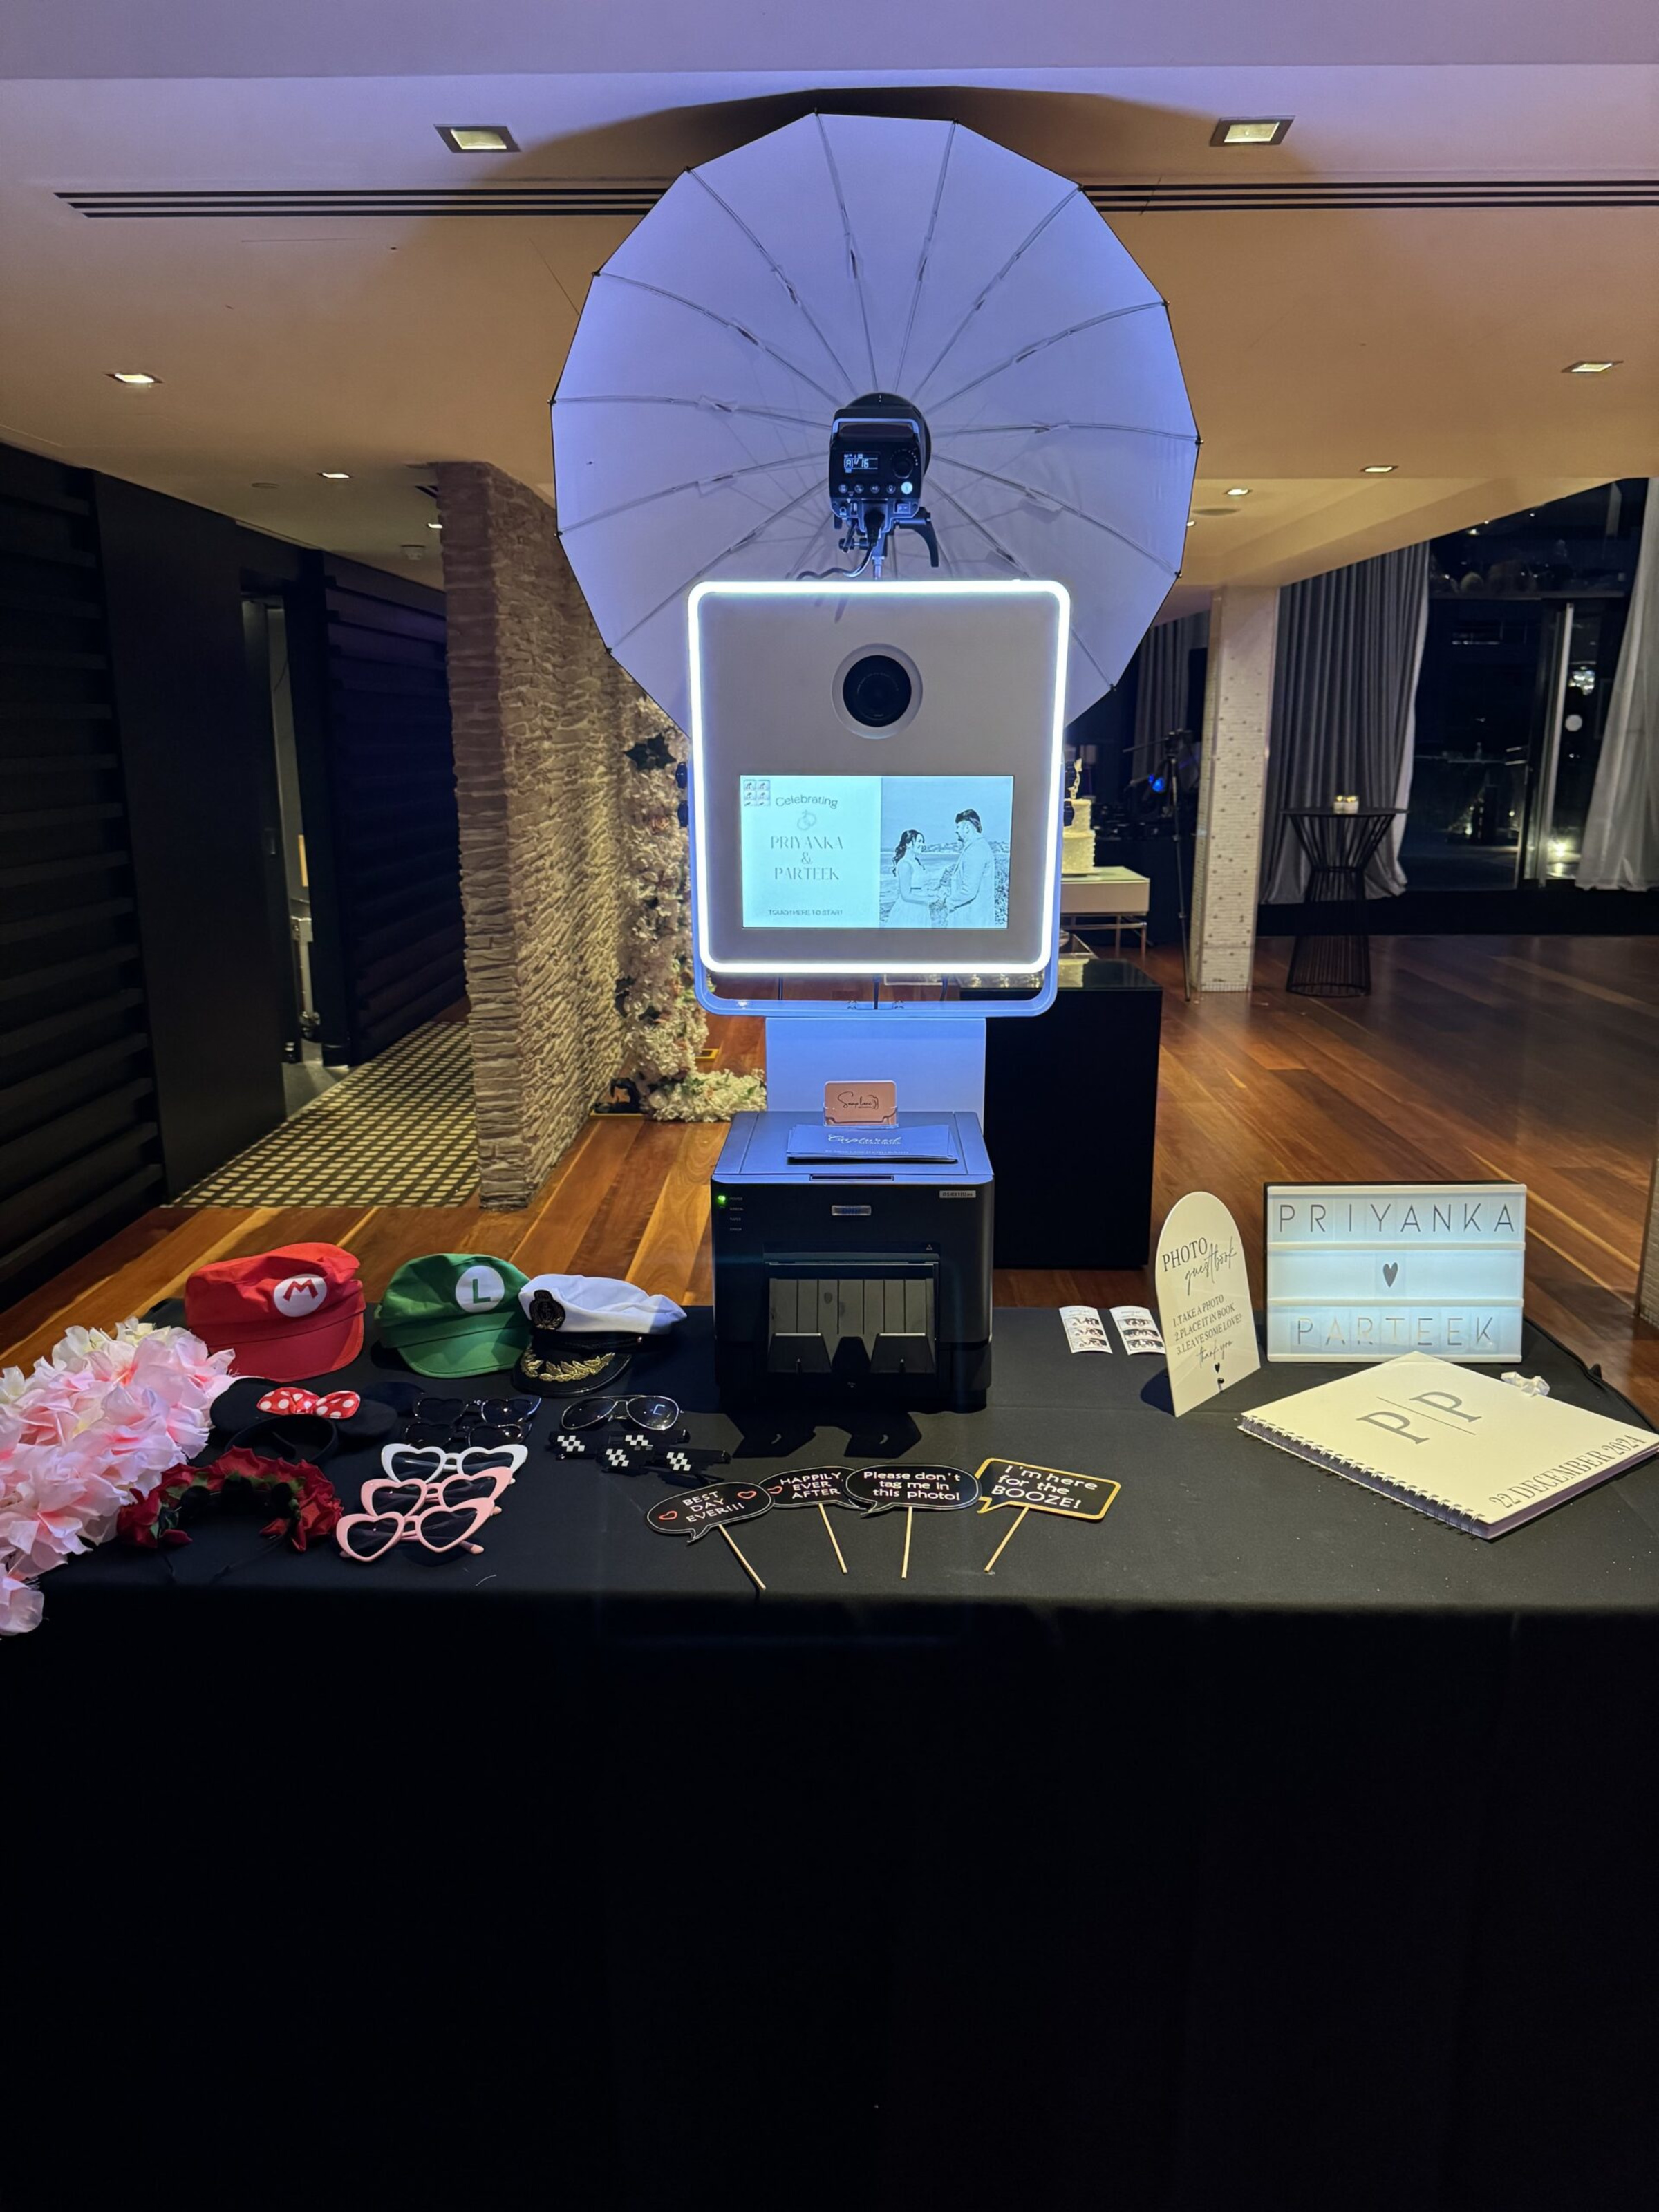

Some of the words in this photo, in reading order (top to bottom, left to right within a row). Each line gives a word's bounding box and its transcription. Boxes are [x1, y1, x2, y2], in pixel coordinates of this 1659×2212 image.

[776, 795, 838, 809] Celebrating
[771, 836, 843, 849] PRIYANKA
[801, 852, 813, 865] &
[775, 868, 840, 880] PARTEEK
[1280, 1203, 1515, 1232] PRIYANKA
[1163, 1237, 1208, 1273] PHOTO
[283, 1279, 319, 1302] M
[472, 1278, 491, 1304] L
[1203, 1295, 1224, 1312] PHOTO
[1217, 1303, 1236, 1320] BOOK
[1206, 1325, 1223, 1342] SOME
[1297, 1318, 1493, 1345] PARTEEK
[1356, 1411, 1430, 1445] P
[1409, 1391, 1482, 1423] P
[780, 1472, 842, 1485] HAPPILY
[864, 1472, 911, 1481] Please
[1046, 1474, 1098, 1491] here
[1490, 1492, 1521, 1508] 22
[1508, 1451, 1615, 1499] DECEMBER
[793, 1488, 841, 1499] AFTER
[794, 1481, 832, 1491] EVER
[880, 1481, 902, 1490] tag
[937, 1482, 950, 1491] in
[999, 1475, 1030, 1488] for
[1038, 1481, 1071, 1496] the
[683, 1491, 720, 1506] BEST
[873, 1488, 902, 1497] this
[908, 1490, 961, 1501] photo!
[992, 1485, 1082, 1510] BOOZE!
[691, 1498, 725, 1512] DAY
